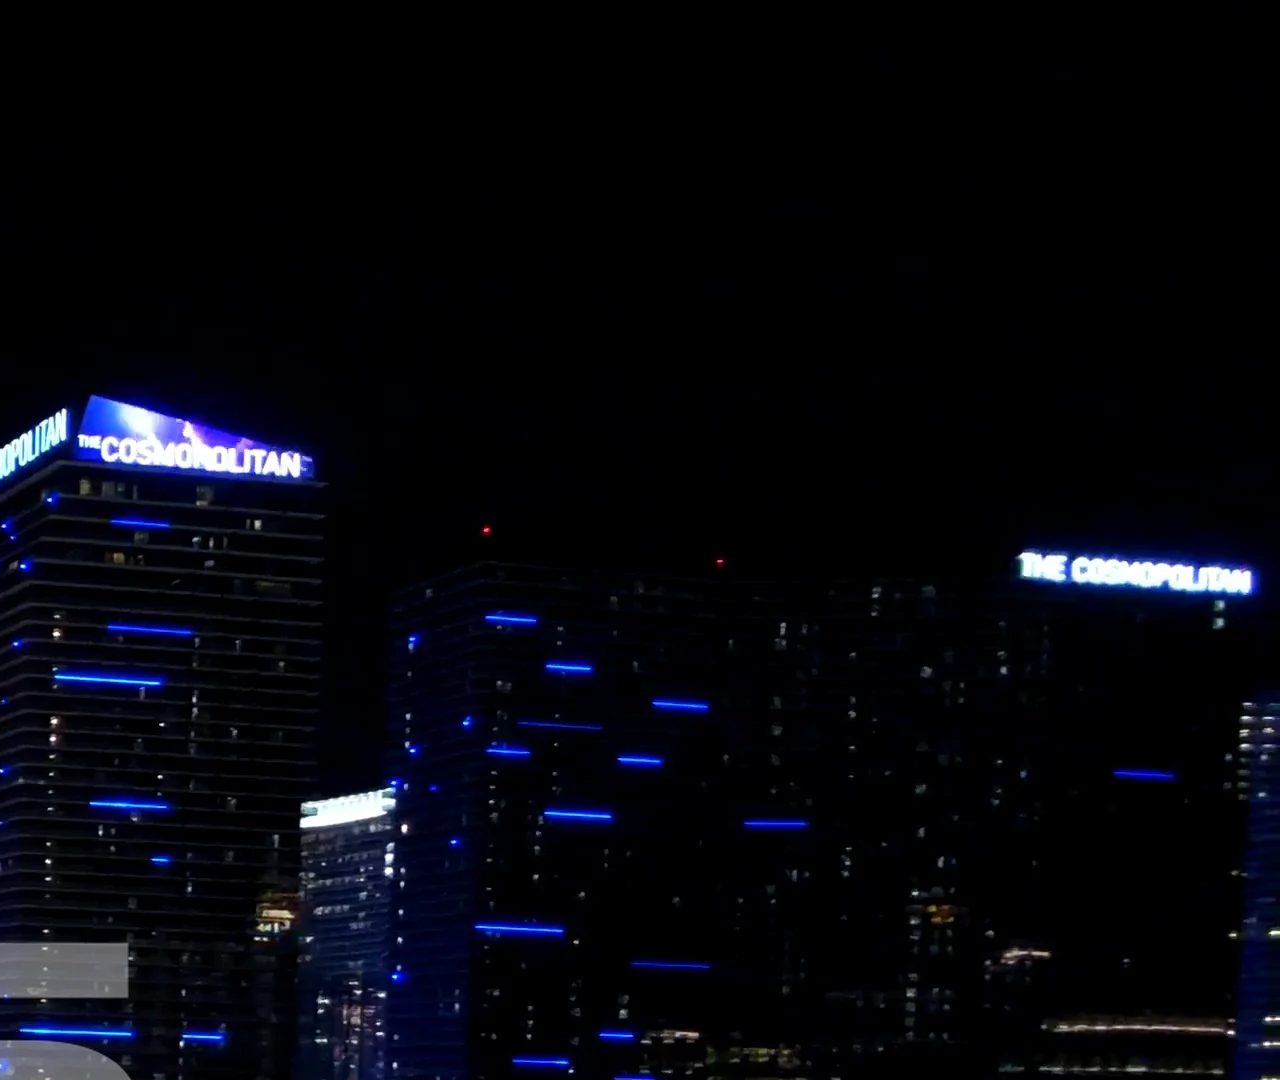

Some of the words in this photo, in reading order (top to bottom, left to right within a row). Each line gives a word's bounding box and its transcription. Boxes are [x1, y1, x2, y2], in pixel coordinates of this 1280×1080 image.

[78, 433, 101, 449] THE
[100, 436, 301, 478] COSMOPOLITAN
[1016, 552, 1068, 581] THE
[1071, 556, 1253, 595] COSMOPOLITAN
